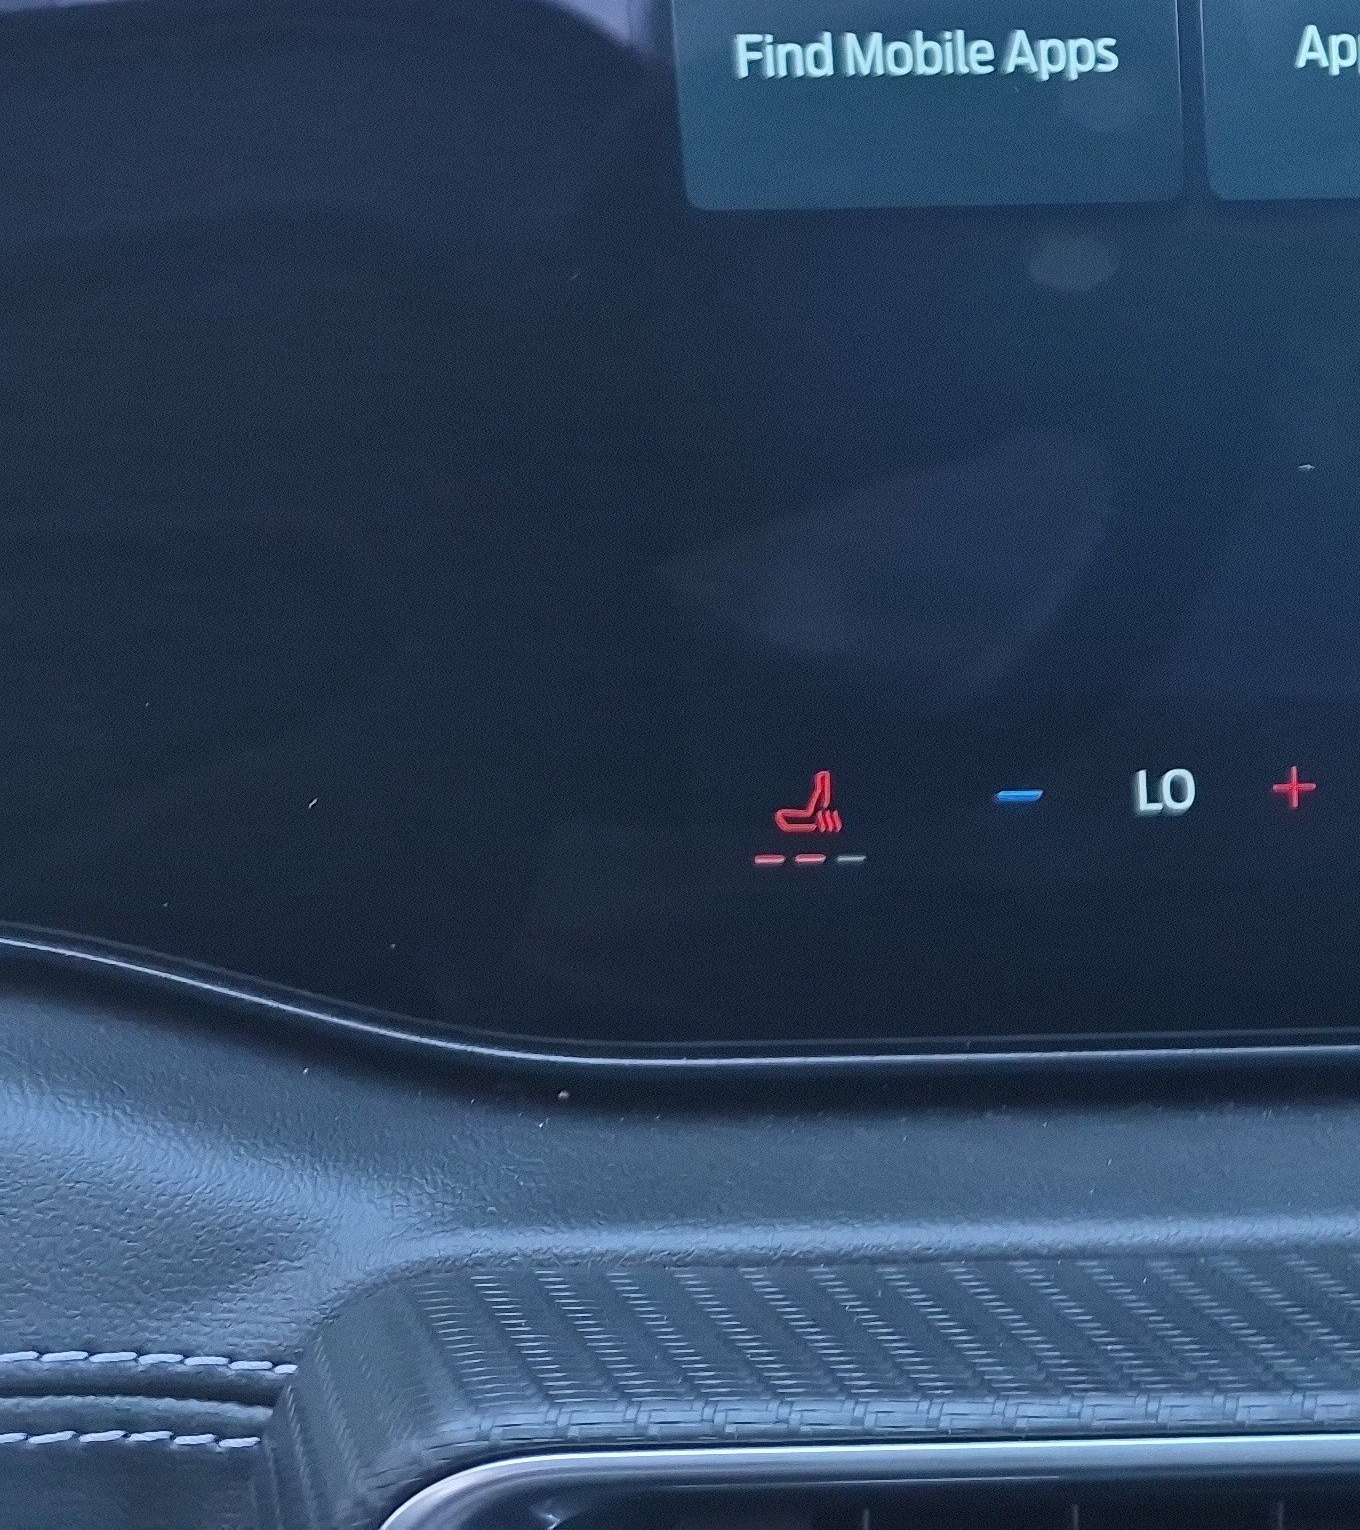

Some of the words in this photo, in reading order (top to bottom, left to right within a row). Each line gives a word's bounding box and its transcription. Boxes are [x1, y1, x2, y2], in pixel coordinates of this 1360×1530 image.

[733, 31, 834, 79] Find
[843, 29, 995, 77] Mobile
[1005, 30, 1120, 81] Apps
[1135, 766, 1197, 815] LO
